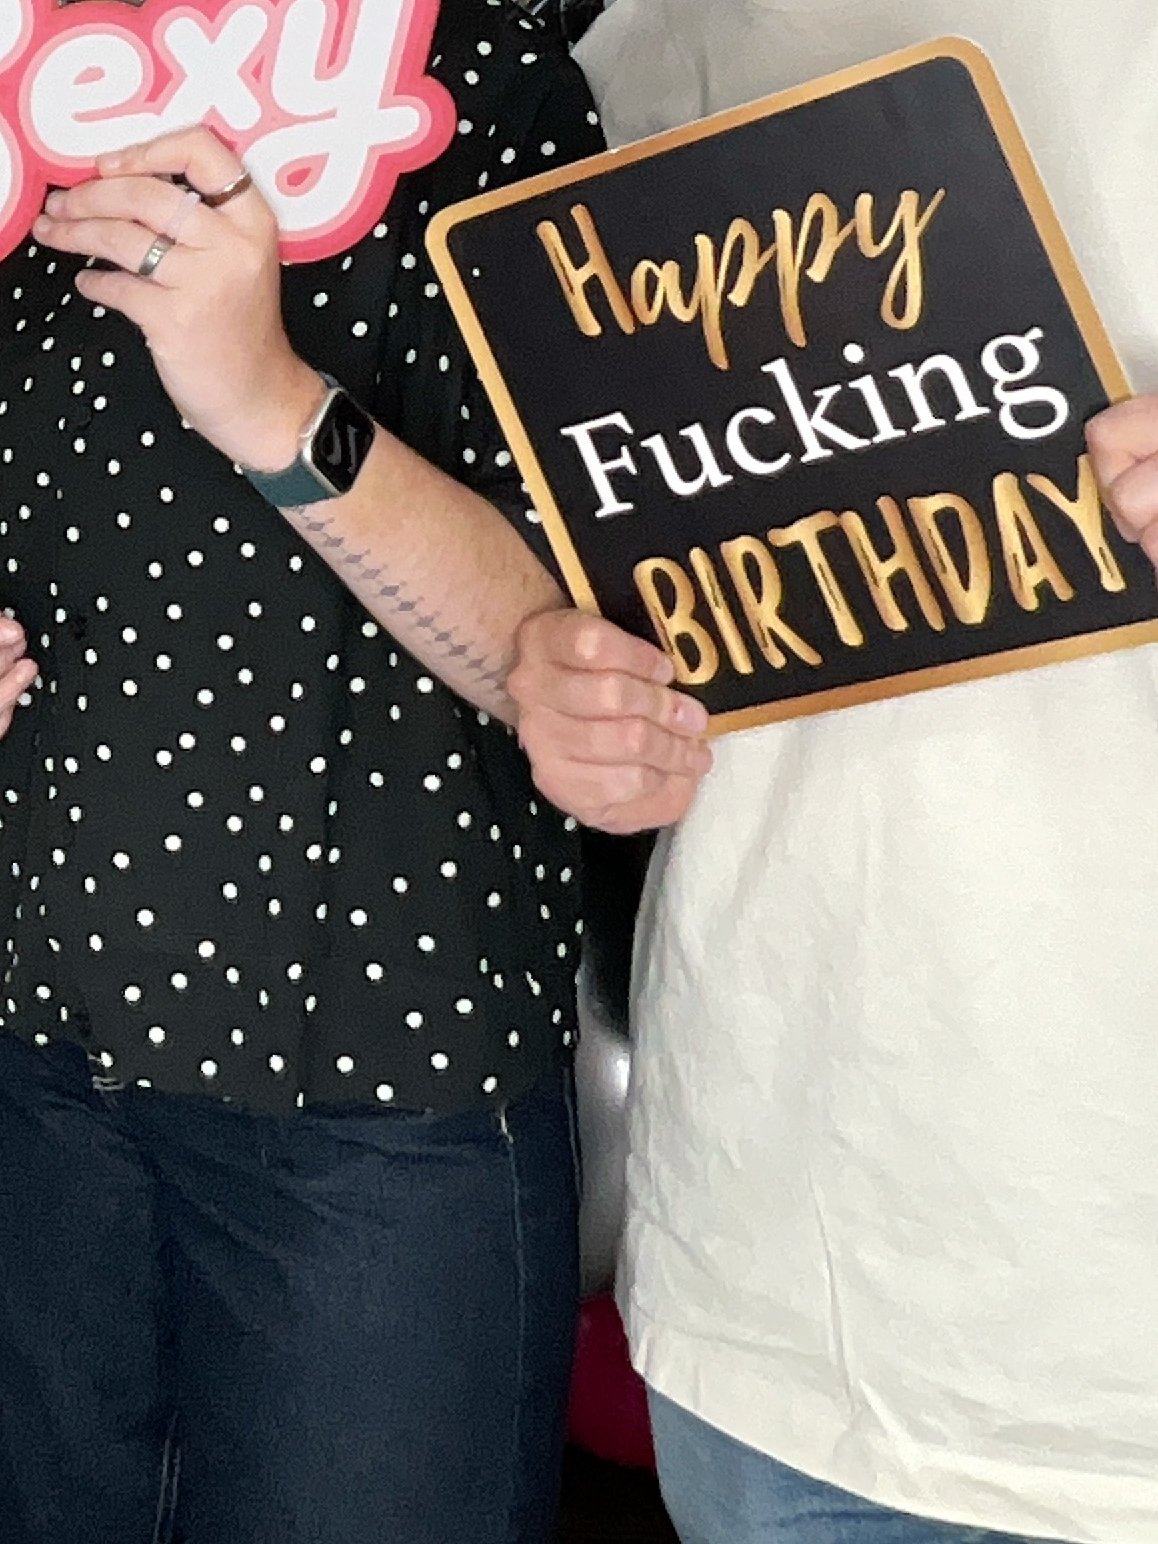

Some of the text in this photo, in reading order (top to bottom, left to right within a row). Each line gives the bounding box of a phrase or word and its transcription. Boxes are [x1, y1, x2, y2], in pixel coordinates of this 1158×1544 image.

[537, 188, 944, 370] Happy
[560, 326, 1070, 518] Fucking
[633, 454, 1126, 687] BIRTHDAY
